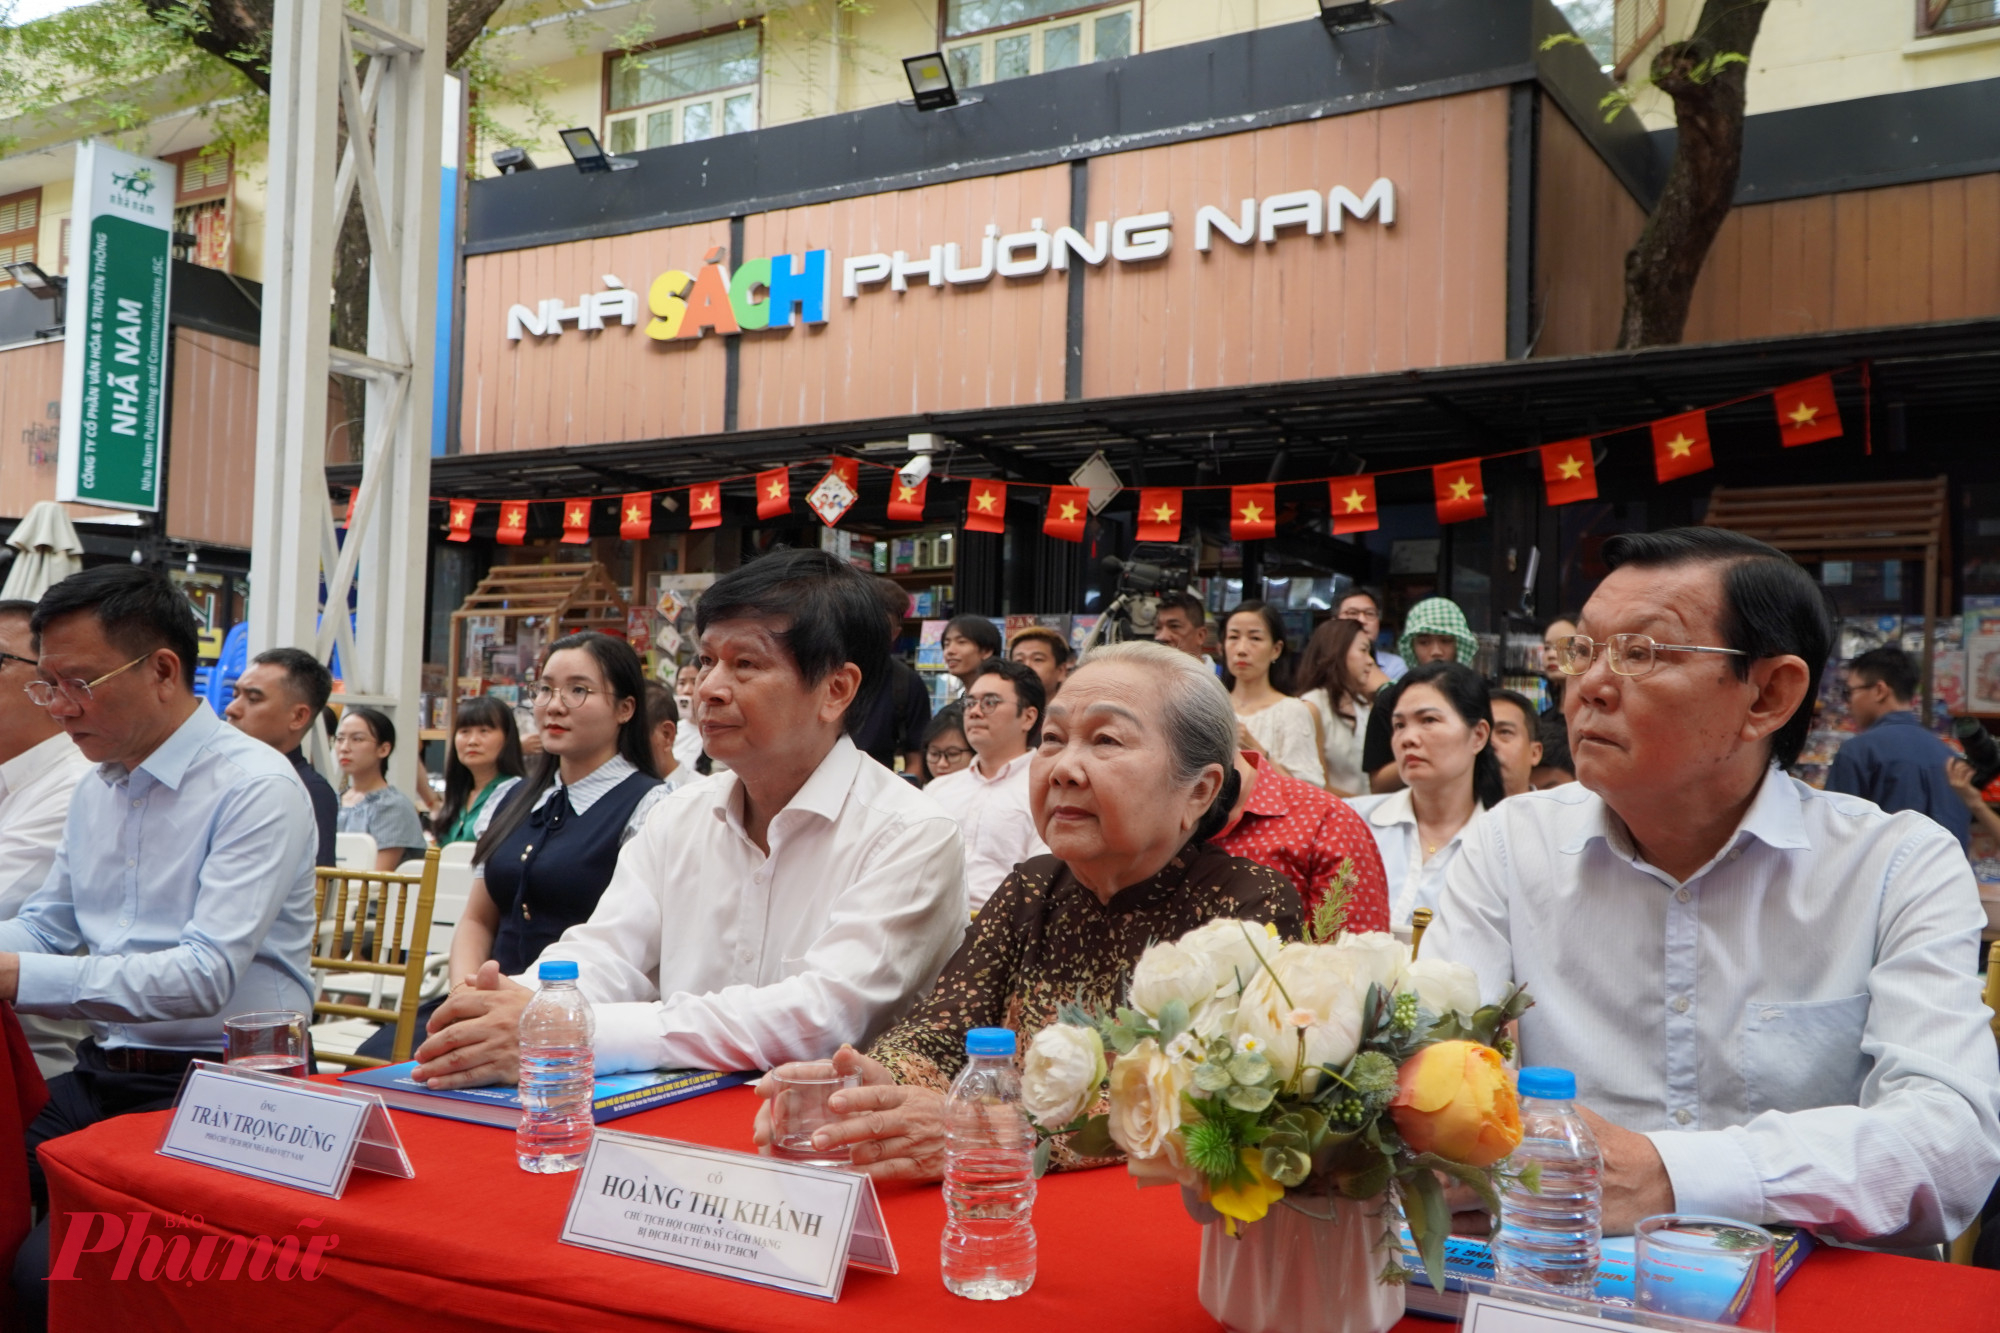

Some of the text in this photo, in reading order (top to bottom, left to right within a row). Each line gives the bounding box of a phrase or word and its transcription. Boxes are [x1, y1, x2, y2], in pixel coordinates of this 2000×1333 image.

[507, 274, 639, 341] NHÀ
[644, 245, 831, 341] SÁCH
[1195, 177, 1396, 252] NAM
[91, 321, 103, 332] &
[147, 278, 163, 364] Communications
[106, 297, 143, 437] NHÃ NAM
[147, 364, 159, 386] and
[143, 386, 159, 441] Publishing
[84, 438, 97, 453] TY
[141, 441, 155, 468] Nam
[81, 454, 97, 489] CÔNG
[141, 468, 153, 492] Nha
[260, 1100, 277, 1113] ÔNG
[233, 1114, 288, 1141] TRỌNG
[288, 1124, 336, 1153] DŨNG
[707, 1171, 724, 1185] CÔ
[601, 1174, 824, 1237] HOÀNG THỊ KHÁNH
[637, 1226, 648, 1239] BỊ
[648, 1229, 670, 1241] ĐỊCH
[724, 1243, 759, 1260] TP.HCM
[644, 1214, 665, 1226] TỊCH
[665, 1218, 683, 1230] HỘI
[683, 1220, 711, 1235] CHIẾN
[725, 1226, 751, 1243] CÁCH
[752, 1234, 782, 1250] MẠNG
